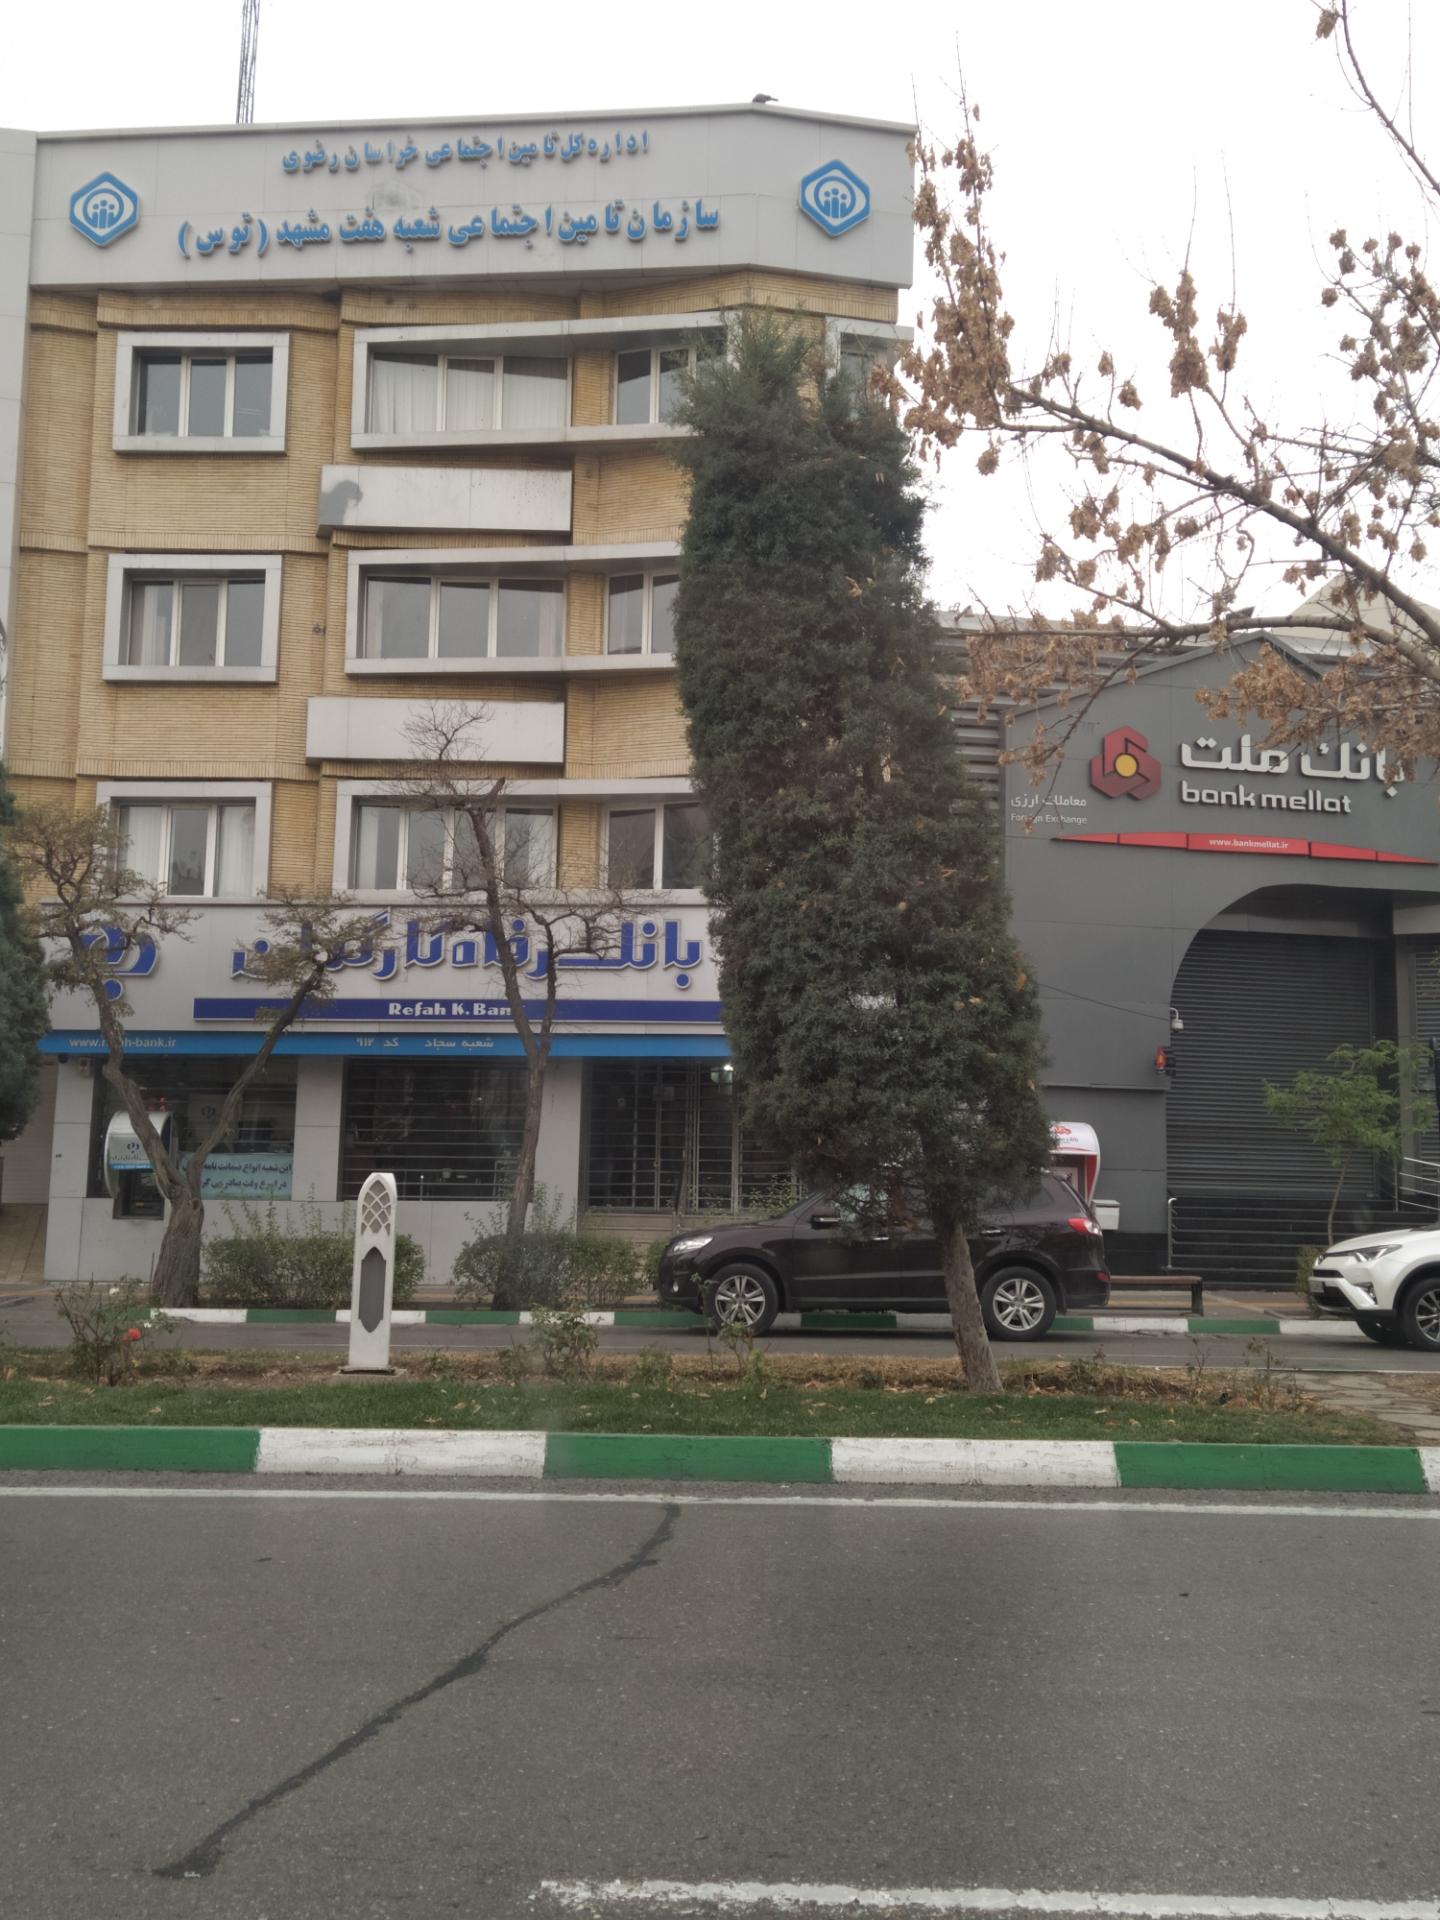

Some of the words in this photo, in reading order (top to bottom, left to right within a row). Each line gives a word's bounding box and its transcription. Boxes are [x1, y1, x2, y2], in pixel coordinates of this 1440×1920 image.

[282, 139, 340, 174] رضوی
[344, 135, 418, 172] خراسان
[425, 135, 504, 169] اجتماعی
[508, 130, 561, 166] تامین
[561, 131, 585, 163] کل
[587, 129, 650, 163] اداره
[276, 207, 332, 251] مشهد
[338, 205, 386, 243] هفت
[393, 206, 441, 254] شعبه
[448, 204, 553, 249] اجتماعی
[557, 199, 625, 244] تامین
[626, 199, 720, 242] سازمان
[1181, 734, 1290, 775] ملت
[1010, 793, 1039, 808] ارزی
[1042, 794, 1087, 807] معاملات
[1181, 780, 1257, 808] bank
[1261, 787, 1352, 814] mellat
[1209, 838, 1289, 850] www.bankmellat.ir
[387, 1002, 446, 1017] Refah
[452, 1002, 470, 1016] K.
[473, 1002, 517, 1016] Ban
[424, 1037, 456, 1051] سجاد
[461, 1036, 494, 1051] شعبه
